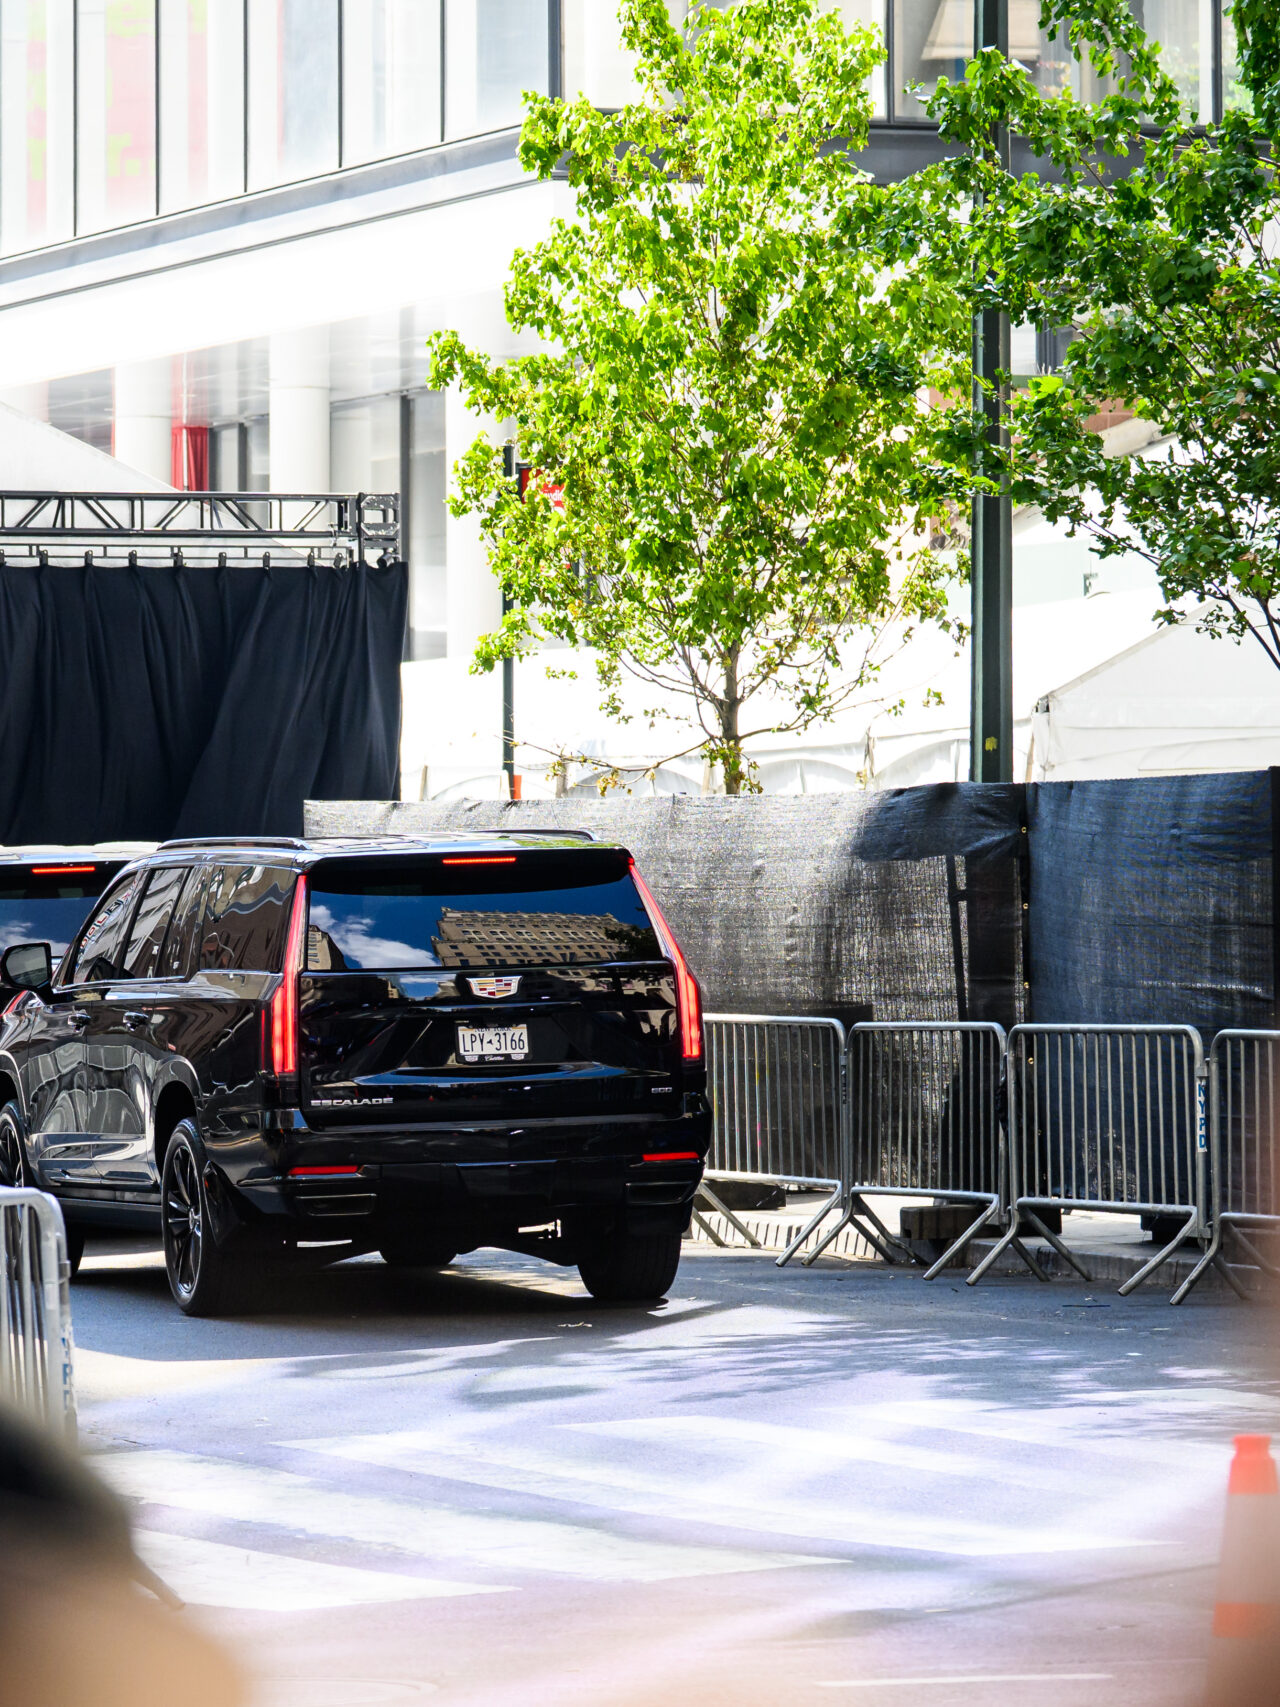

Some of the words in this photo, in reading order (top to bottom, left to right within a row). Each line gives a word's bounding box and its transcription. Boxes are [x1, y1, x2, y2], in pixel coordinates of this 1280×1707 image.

[494, 1032, 525, 1051] 3166
[310, 1097, 394, 1106] ESCALADE
[1197, 1083, 1206, 1148] NYPD
